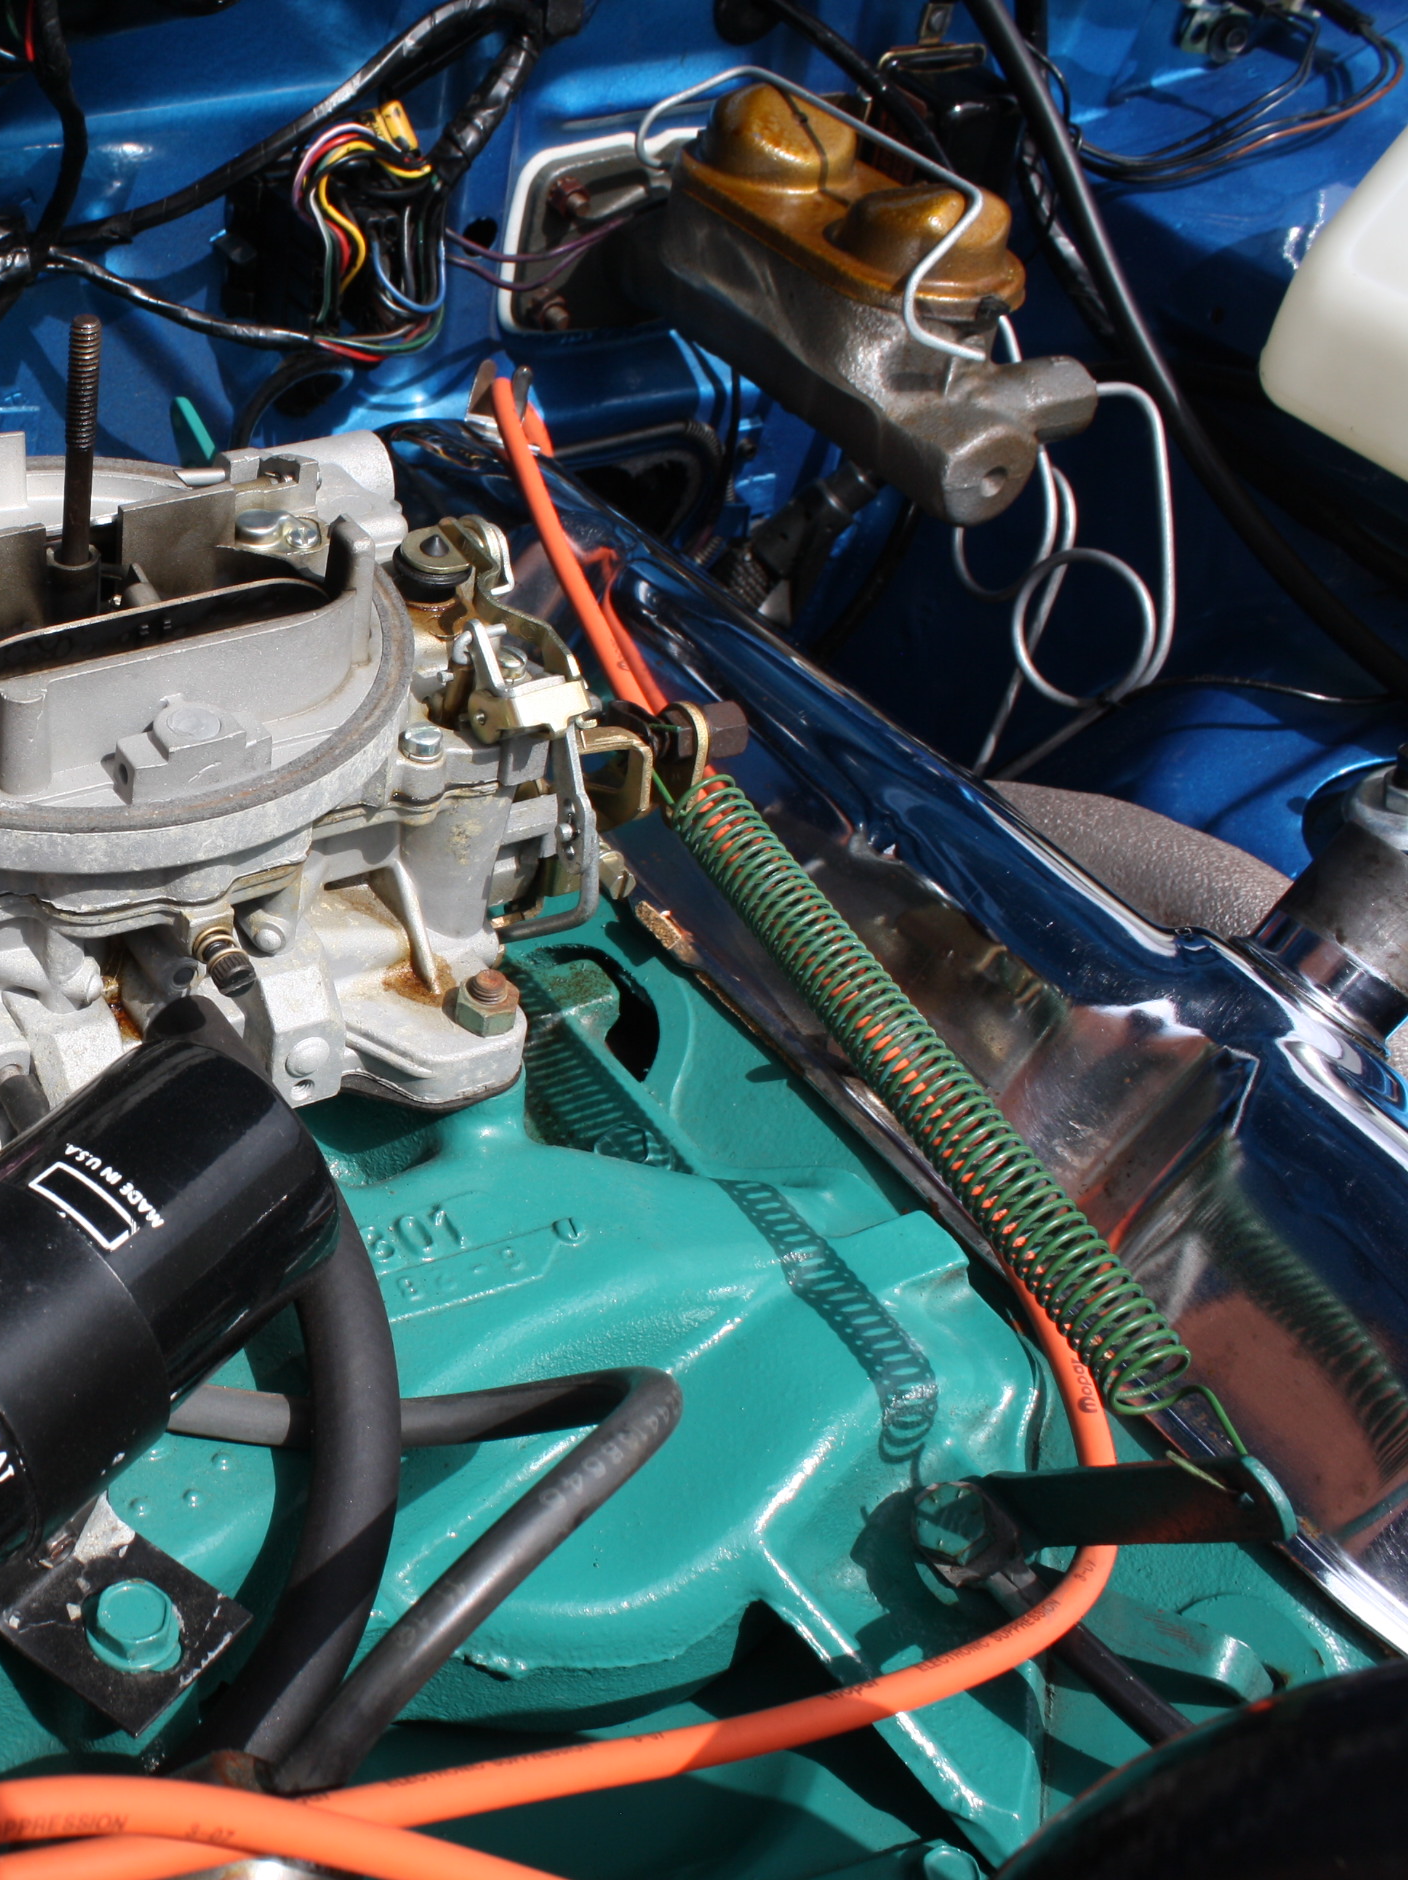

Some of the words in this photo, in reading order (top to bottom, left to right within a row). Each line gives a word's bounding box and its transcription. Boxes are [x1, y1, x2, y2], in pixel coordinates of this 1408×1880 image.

[100, 1166, 123, 1185] IN
[119, 1182, 165, 1228] MADE
[915, 1640, 990, 1673] ELECTRONIC
[994, 1598, 1061, 1643] SUPPRESSION
